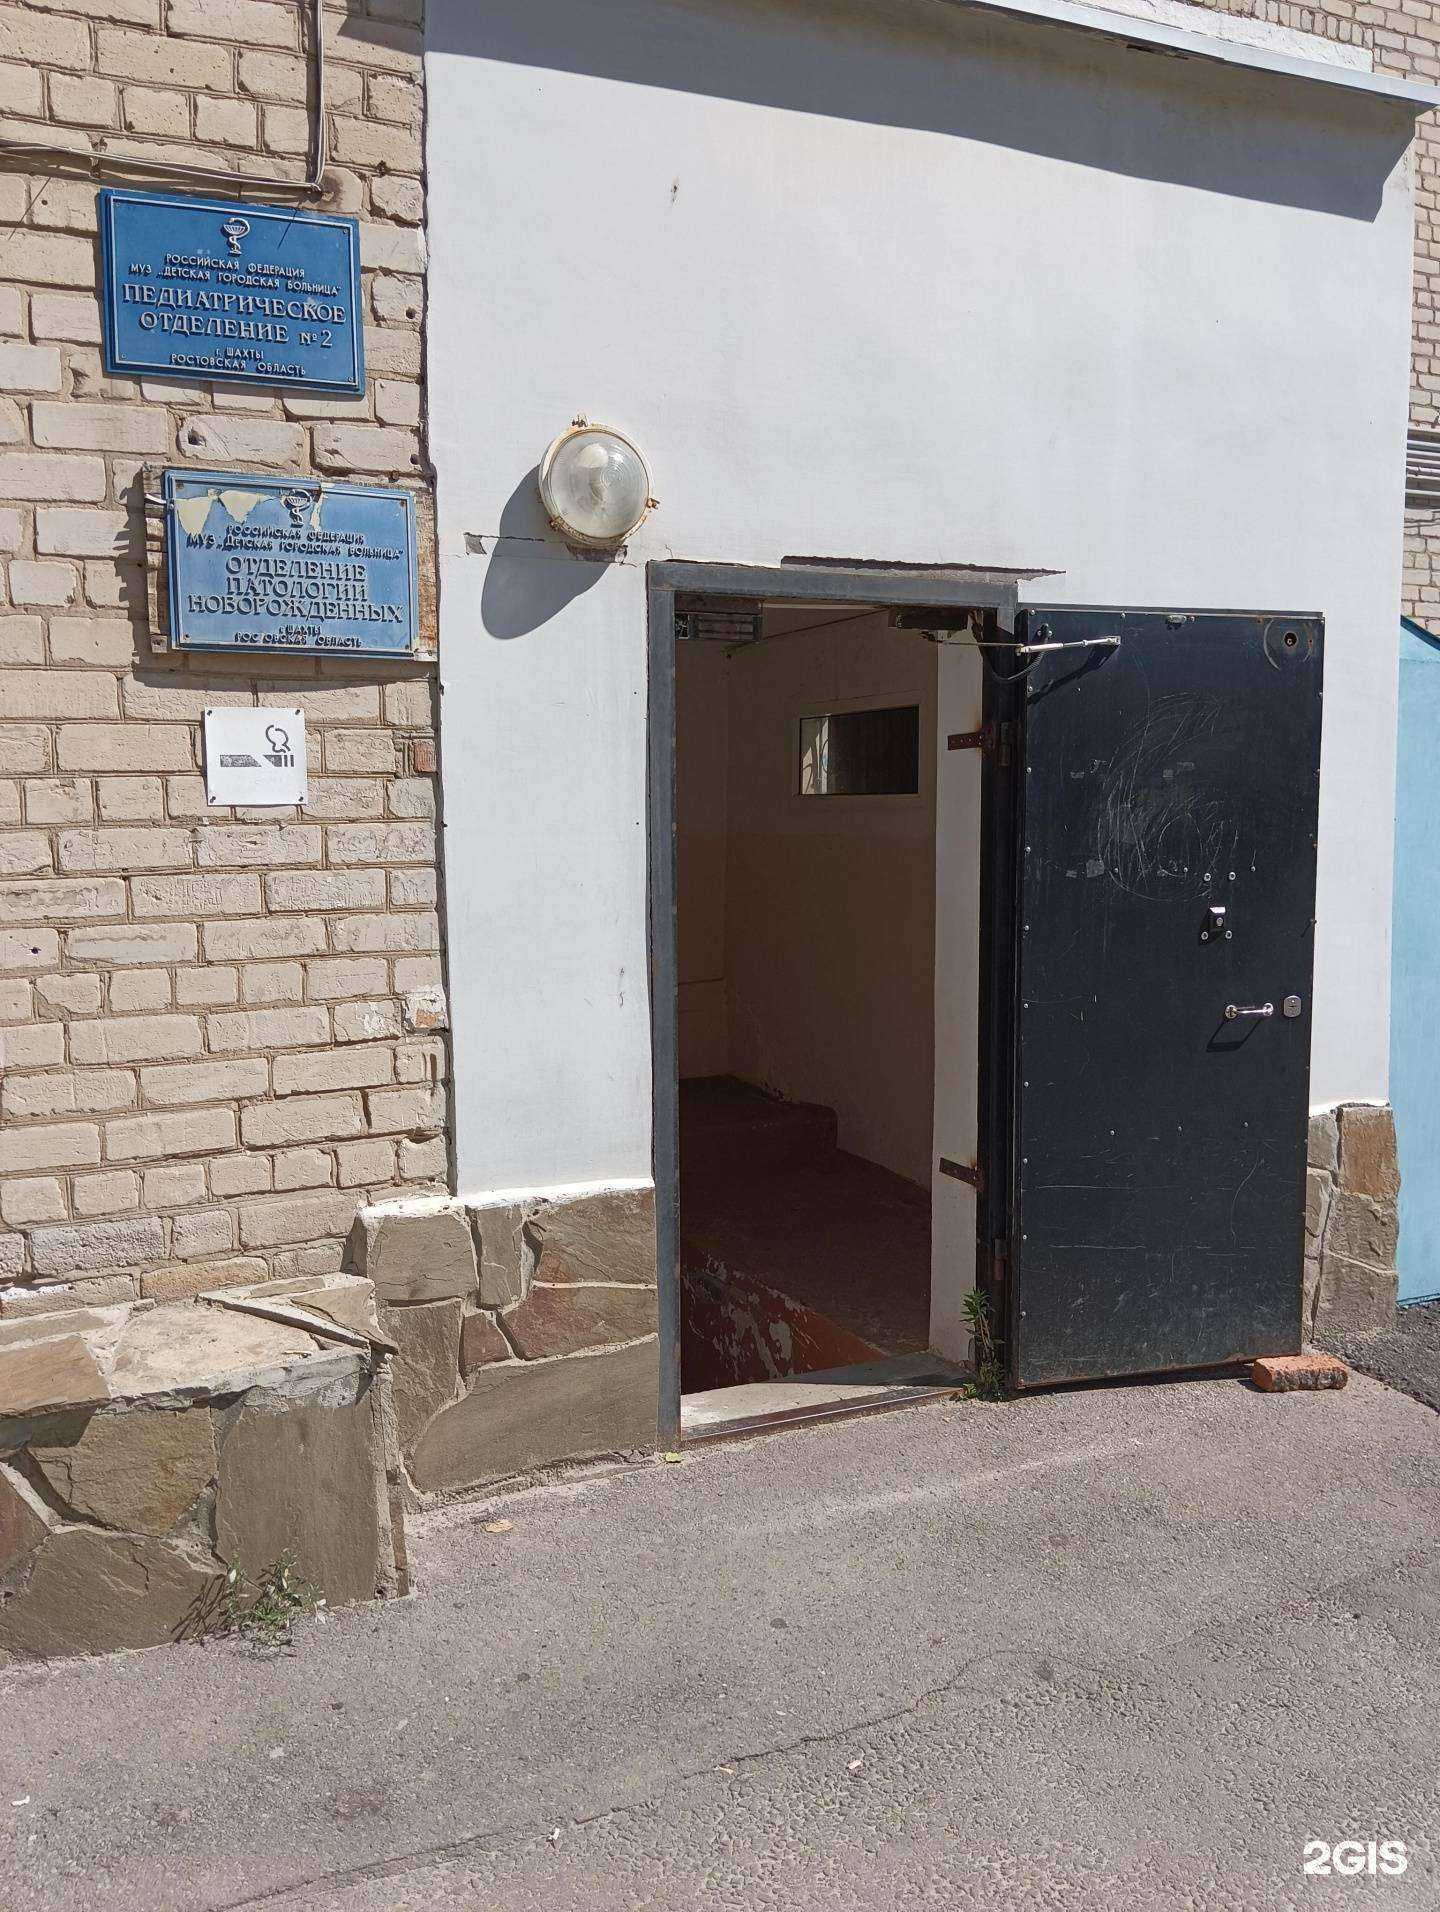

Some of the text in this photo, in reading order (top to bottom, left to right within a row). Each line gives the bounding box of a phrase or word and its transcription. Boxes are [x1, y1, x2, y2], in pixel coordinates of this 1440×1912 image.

[130, 263, 152, 274] МУЗ
[218, 273, 280, 288] ГОРОДСКАЯ
[165, 253, 305, 278] РОССИЙСКАЯ ФЕДЕРАЦИЯ
[123, 284, 346, 323] ПЕДИАТРИЧЕСКОЕ
[139, 312, 289, 342] ОТДЕЛЕНИЕ
[171, 353, 305, 375] РОСТОВСКАЯ ОБЛАСТЬ
[226, 347, 264, 359] ШАХТЫ
[226, 525, 364, 544] РОССИЙСКАЯ ФЕДЕРАЦИЯ
[279, 543, 341, 557] ГОРОДСКАЯ
[226, 557, 367, 582] ОТДЕЛЕНИЕ
[226, 577, 368, 602] ПАТОЛОГИИ
[188, 595, 403, 623] НОВОРОЖДЕННЫХ
[315, 636, 361, 647] ОБЛАСТЬ
